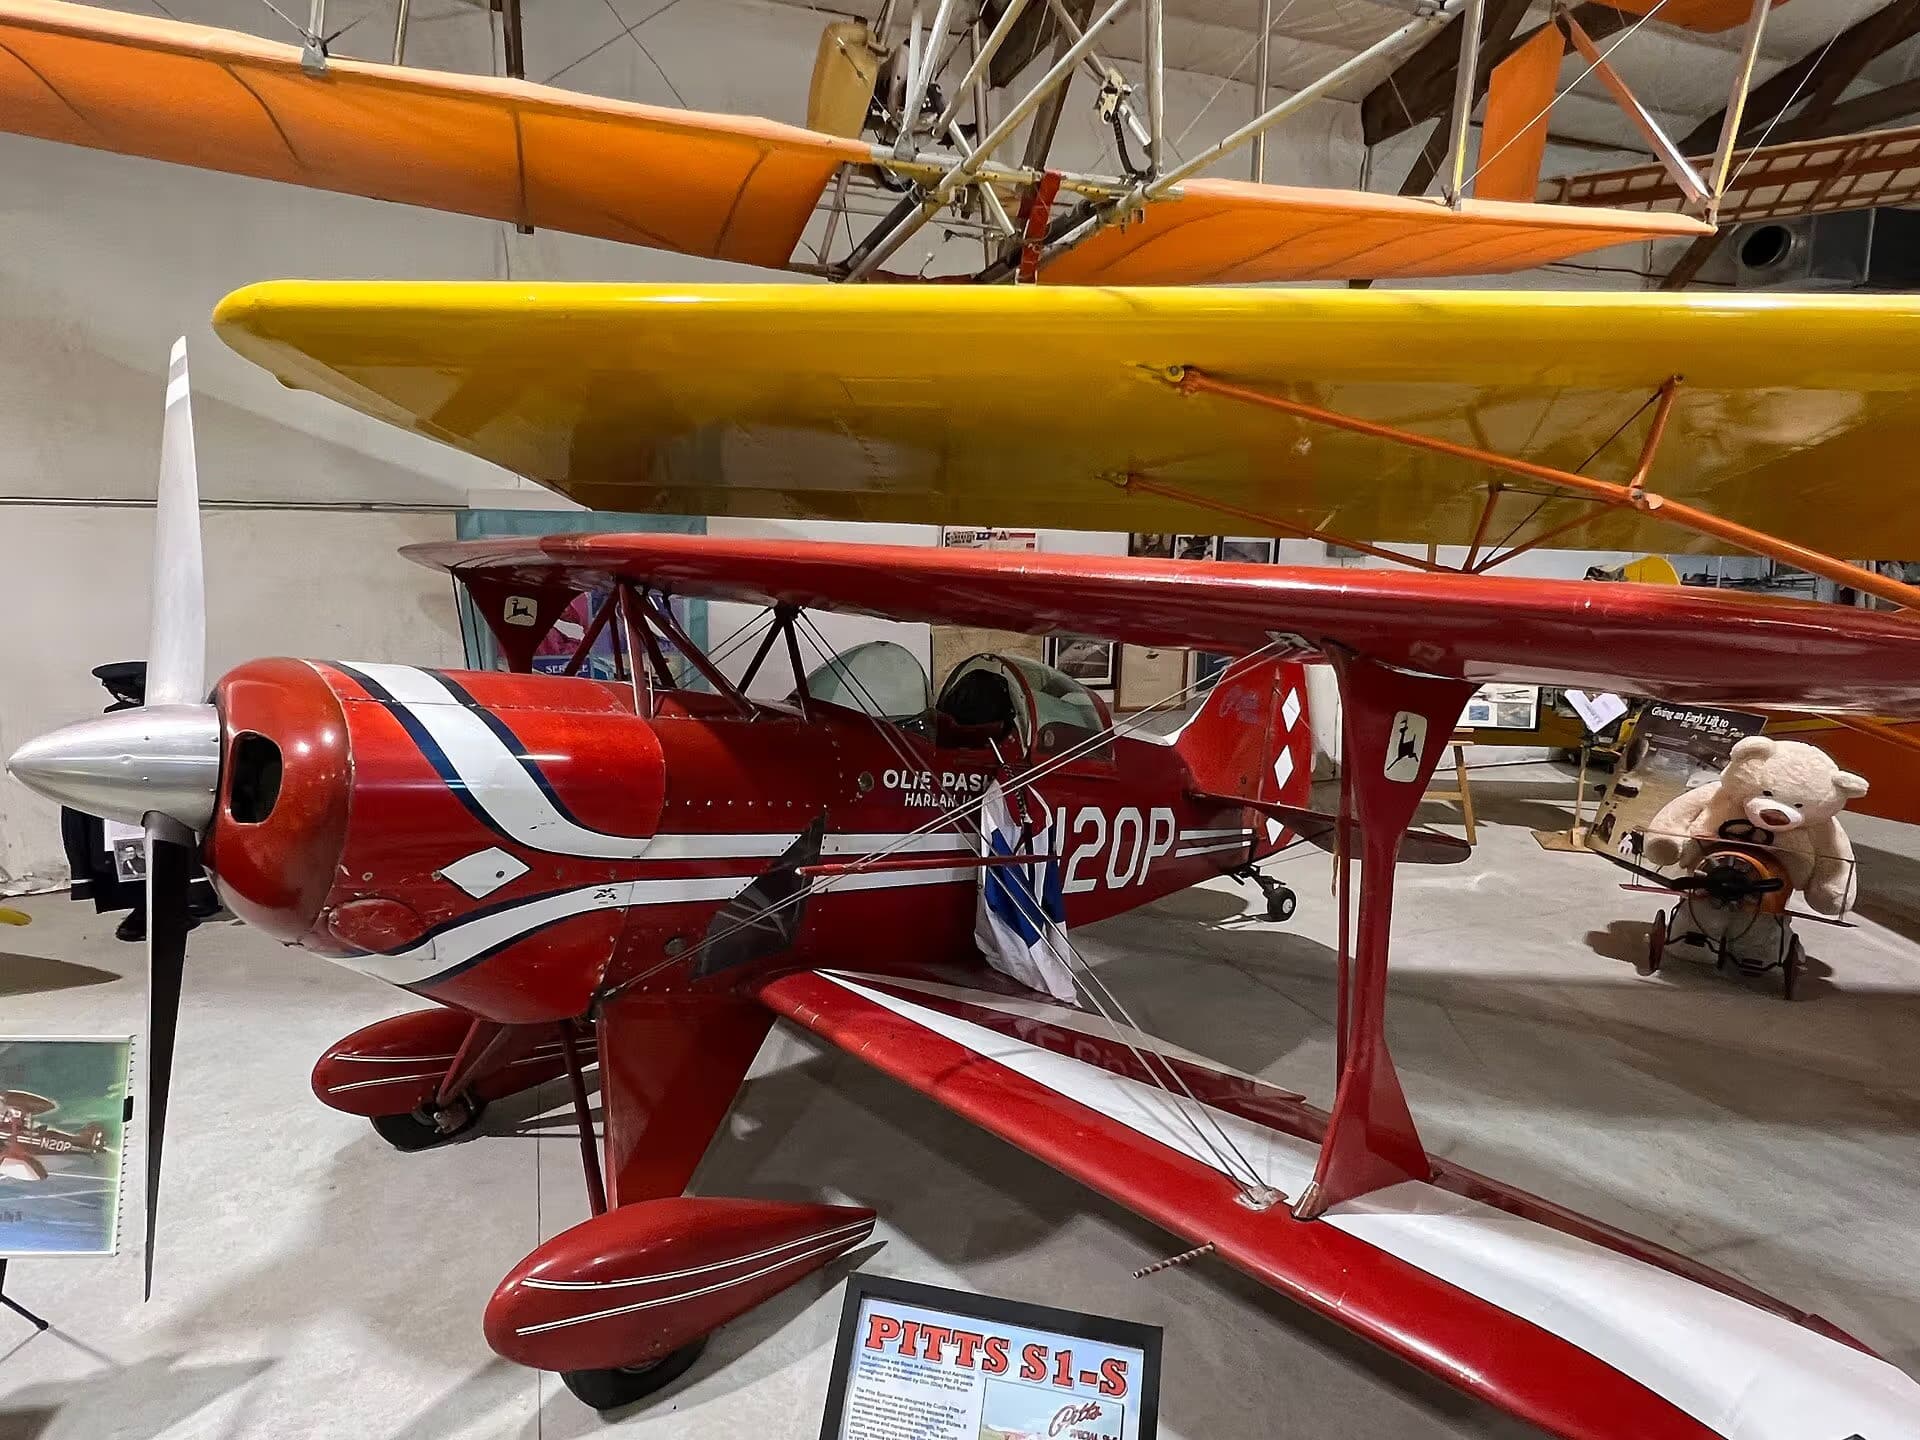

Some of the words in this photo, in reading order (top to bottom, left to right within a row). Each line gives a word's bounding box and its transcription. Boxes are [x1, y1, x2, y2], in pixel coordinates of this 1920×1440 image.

[545, 664, 588, 674] SERE
[1651, 706, 1674, 720] Giving
[1674, 712, 1685, 720] an
[1684, 711, 1705, 725] Early
[1719, 718, 1729, 728] to
[41, 1137, 71, 1152] N20P
[865, 1314, 1010, 1374] PITTS
[1020, 1343, 1128, 1398] S1-S
